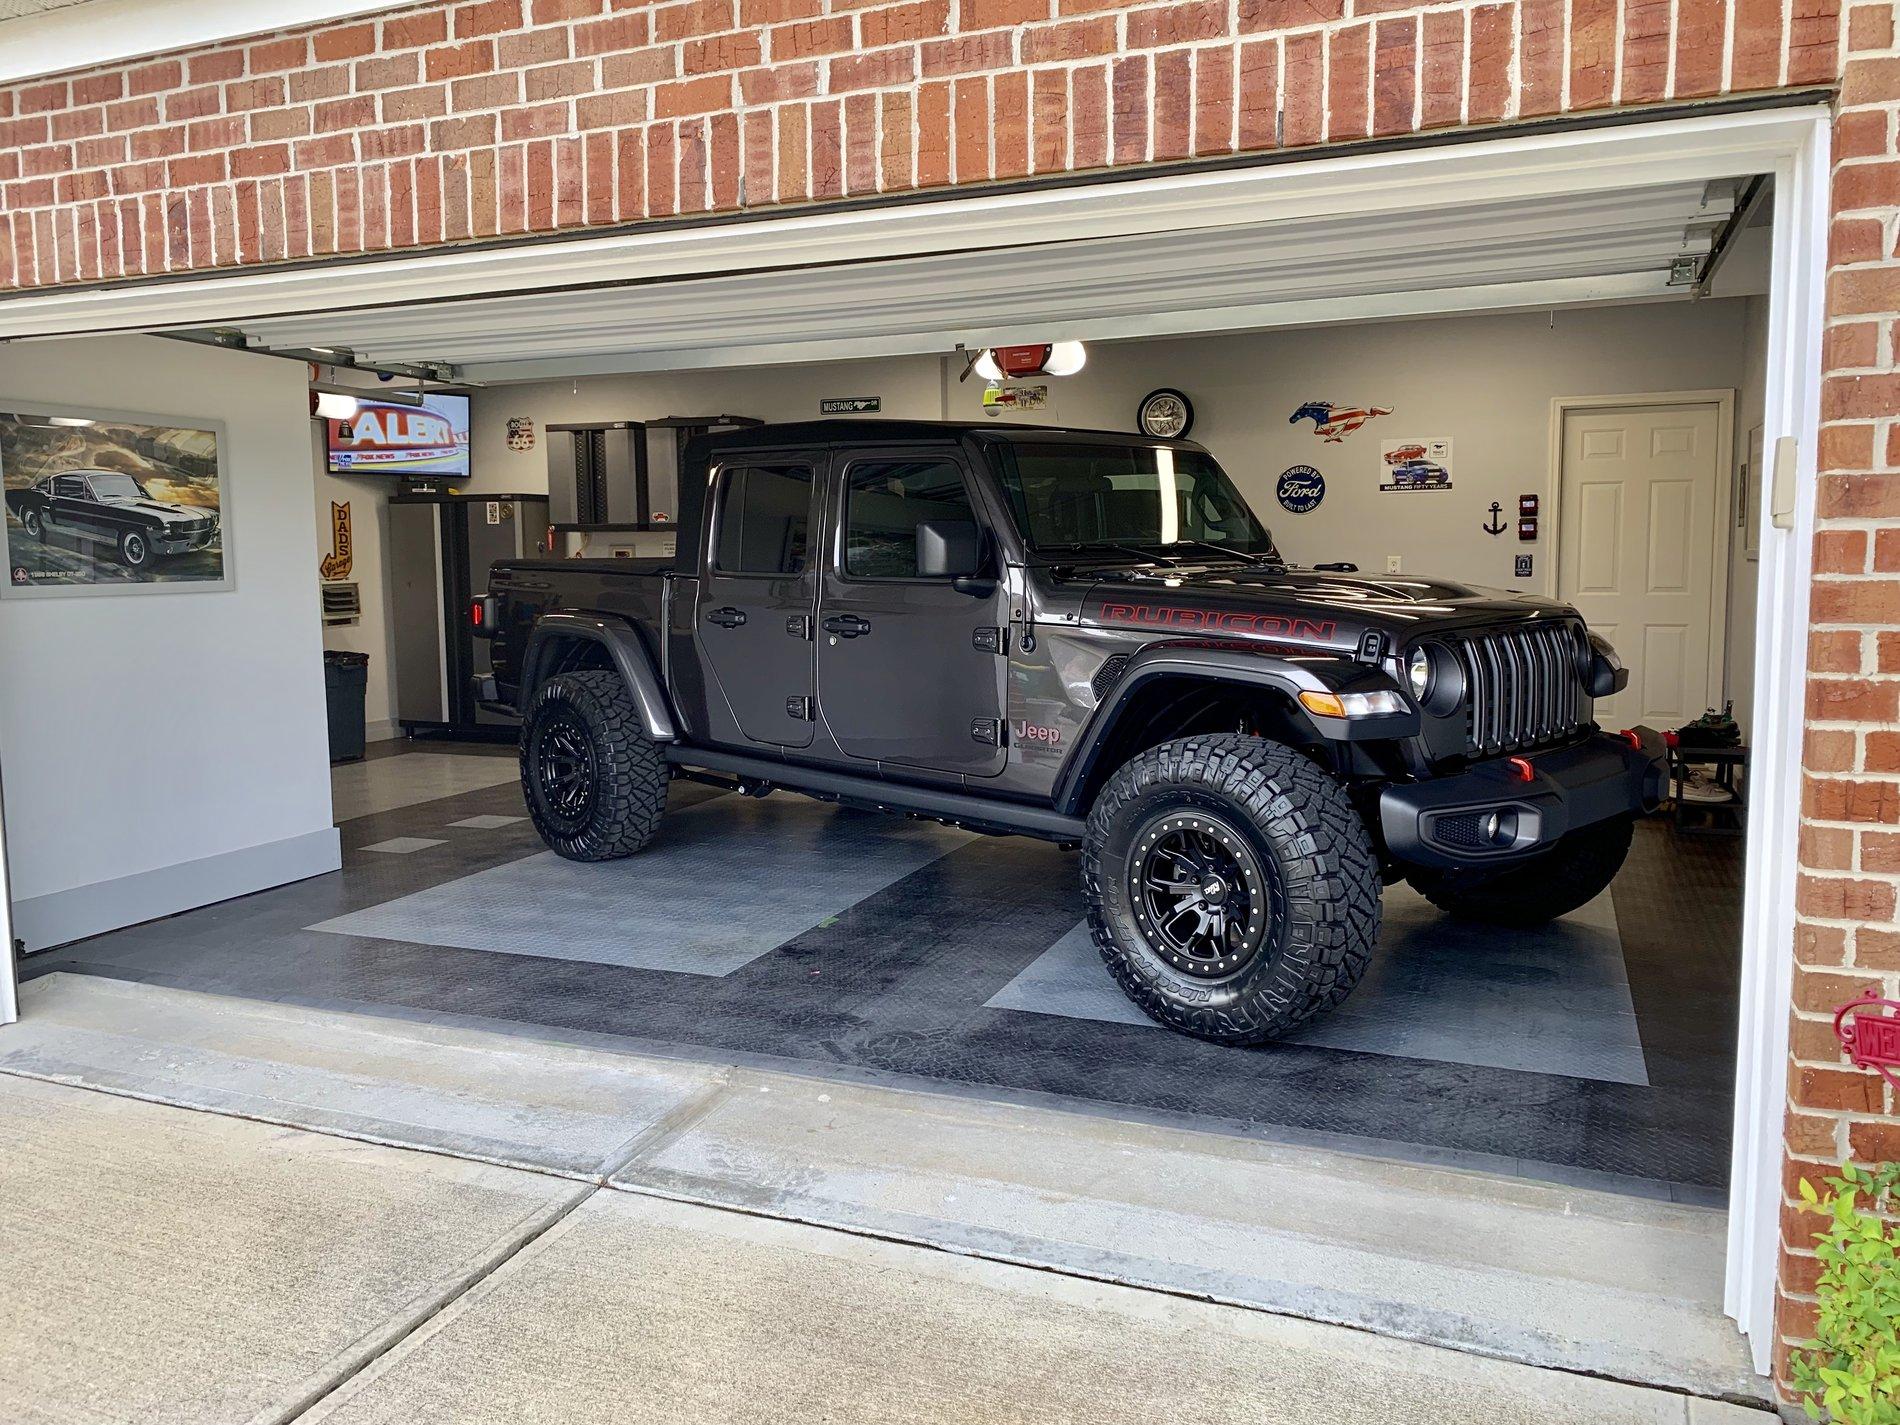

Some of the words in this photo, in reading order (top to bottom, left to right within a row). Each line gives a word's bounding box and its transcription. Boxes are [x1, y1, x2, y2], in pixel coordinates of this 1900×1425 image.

[823, 401, 853, 411] MUSTANG
[351, 412, 450, 445] ALERT
[513, 434, 529, 449] 66
[1283, 466, 1312, 480] POWERED
[1311, 471, 1321, 480] BY
[1279, 480, 1322, 498] Ford
[1283, 499, 1298, 511] BUILT
[1304, 499, 1318, 511] LAST
[337, 509, 349, 556] DADS
[1101, 603, 1337, 641] RUBICON
[1015, 720, 1060, 745] Jeep
